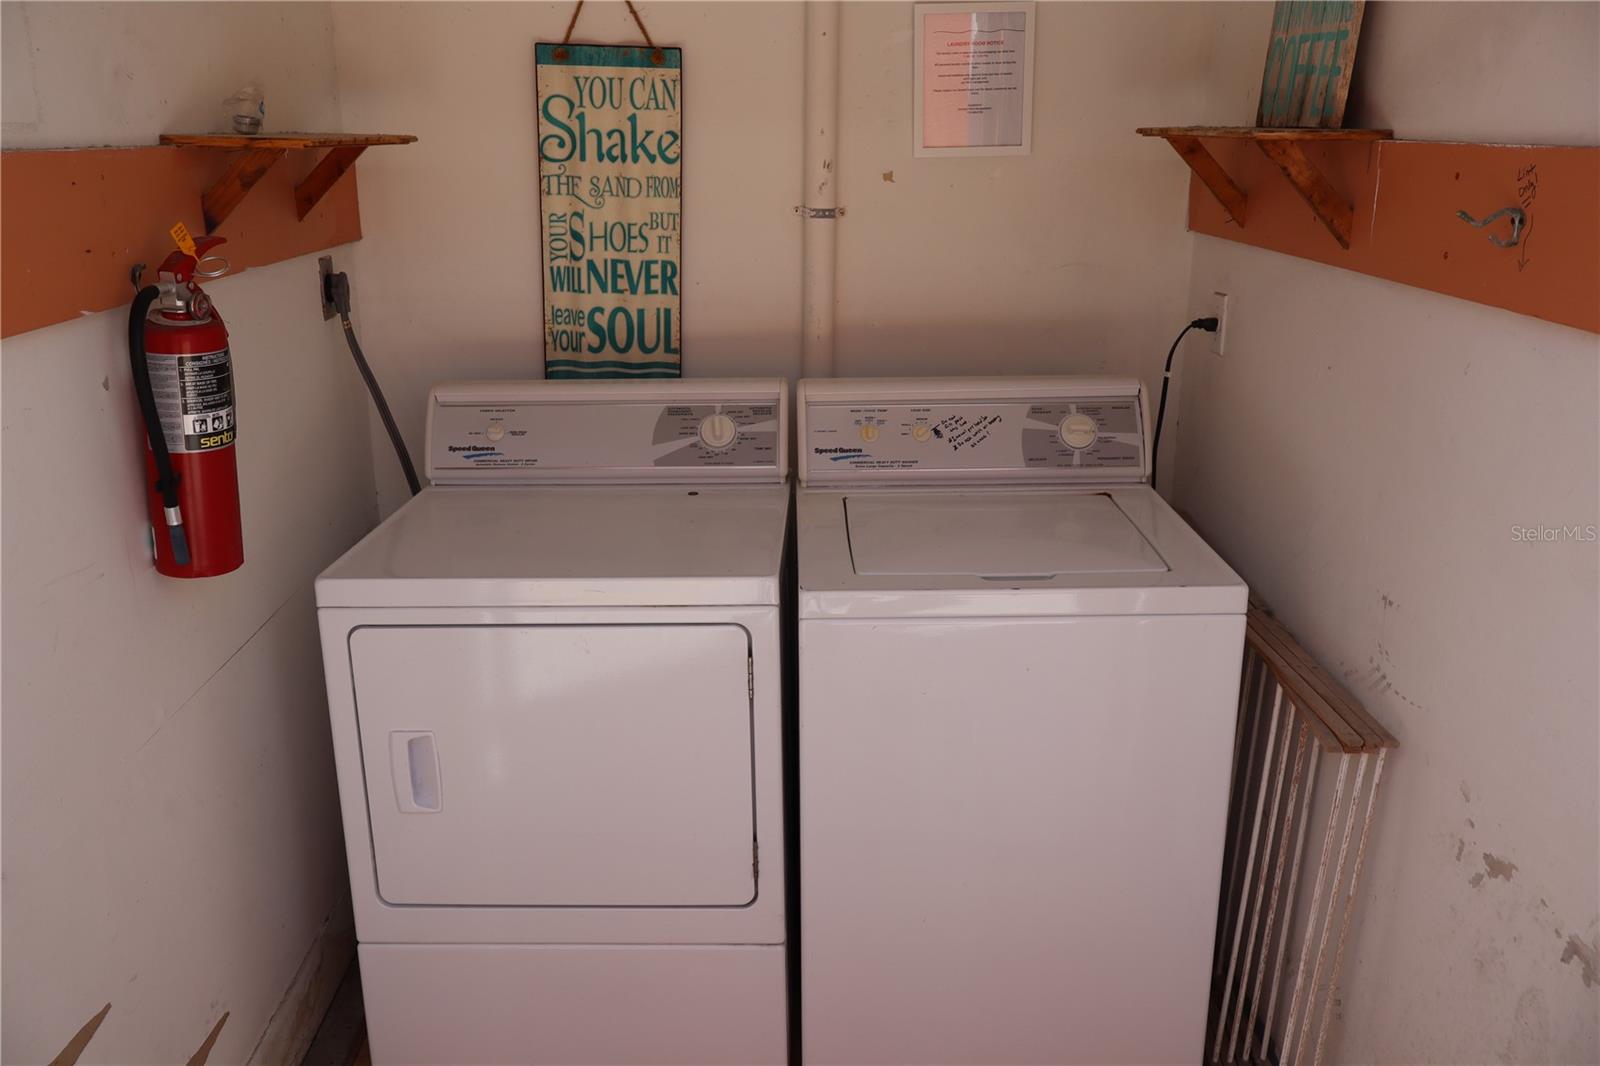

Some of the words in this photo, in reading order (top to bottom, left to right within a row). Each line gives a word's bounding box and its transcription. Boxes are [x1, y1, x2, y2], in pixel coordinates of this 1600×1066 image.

[573, 76, 624, 110] YOU
[629, 77, 679, 111] CAN
[540, 94, 680, 165] Shake
[588, 175, 642, 199] SAND
[645, 175, 680, 199] FROM
[649, 211, 680, 231] BUT
[549, 211, 568, 263] YOUR
[568, 208, 650, 265] SHOES
[657, 235, 672, 254] IT
[550, 265, 585, 294] WILL
[586, 258, 679, 296] NEVER
[551, 305, 585, 327] leave
[586, 305, 679, 354] SOUL
[448, 445, 471, 453] Speed
[814, 447, 838, 455] Speed
